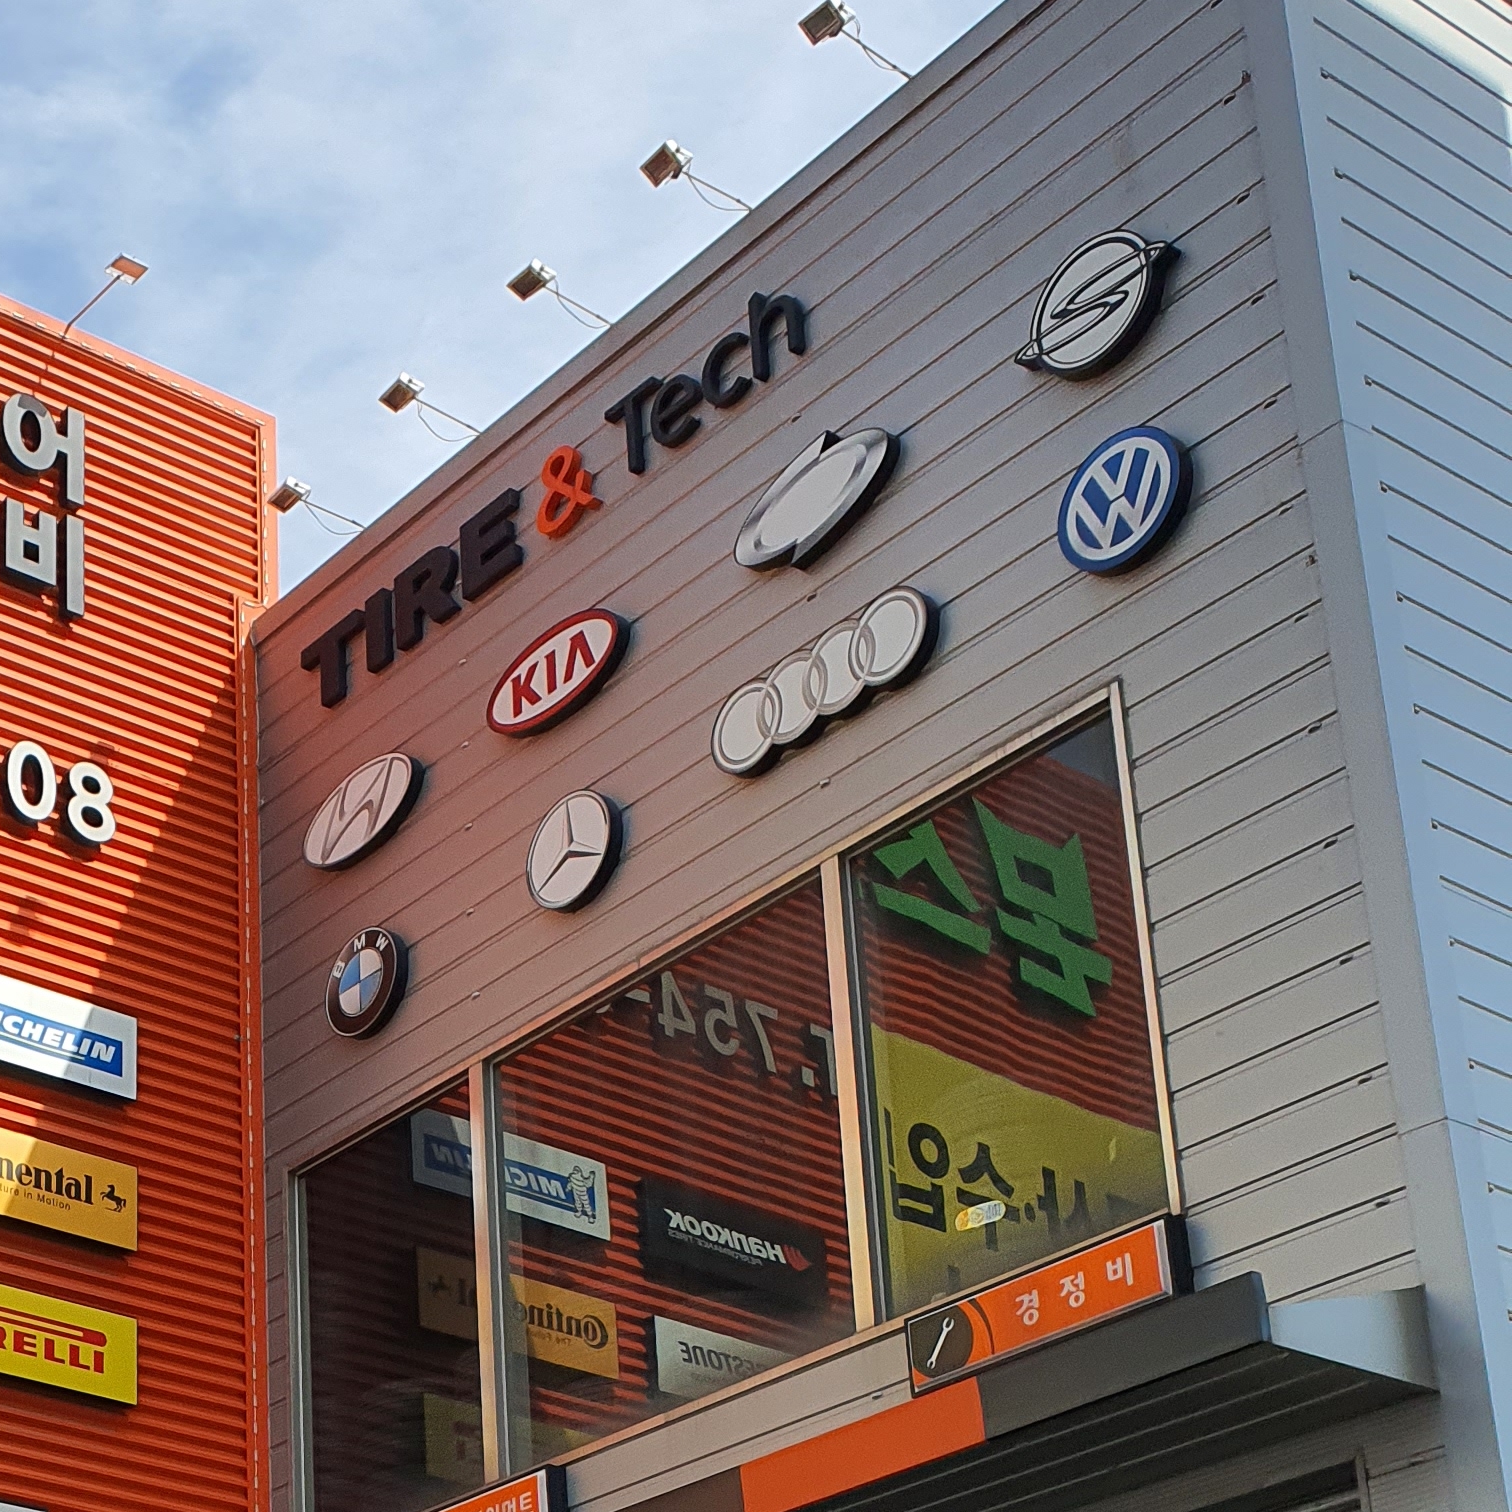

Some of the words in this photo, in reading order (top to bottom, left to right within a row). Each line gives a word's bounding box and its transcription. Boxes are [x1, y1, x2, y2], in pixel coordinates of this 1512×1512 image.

[301, 488, 524, 708] TIRE
[537, 445, 602, 538] &
[604, 291, 805, 474] Tech
[511, 629, 597, 719] KIA
[332, 933, 388, 979] BMW
[36, 1191, 72, 1212] Motion
